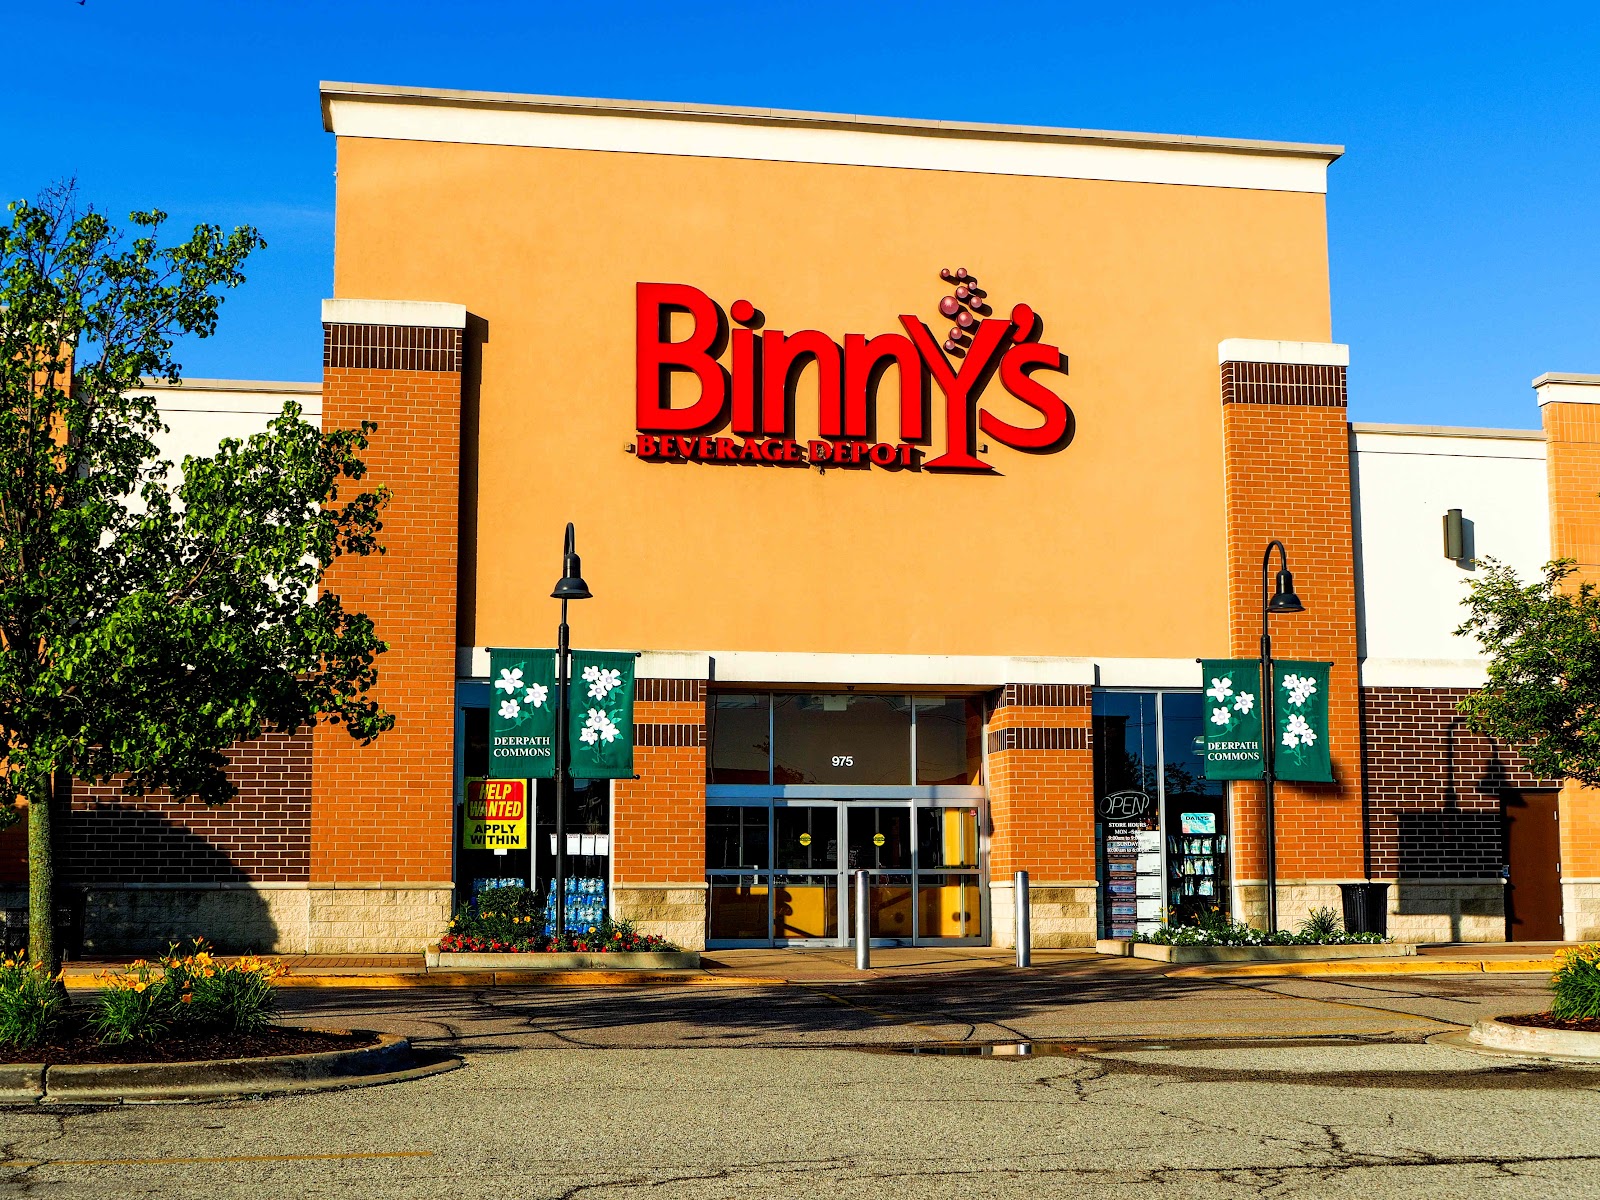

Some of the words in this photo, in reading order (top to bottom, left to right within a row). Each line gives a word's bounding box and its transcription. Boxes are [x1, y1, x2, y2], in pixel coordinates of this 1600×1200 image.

[636, 434, 799, 461] BEVERAGE
[807, 439, 915, 466] DEPOT
[493, 736, 551, 746] DEERPATH
[1207, 741, 1259, 750] DEERPATH
[493, 747, 551, 757] COMMONS
[1207, 751, 1260, 761] COMMONS
[831, 755, 854, 767] 975
[478, 783, 512, 800] HELP
[469, 801, 522, 817] WANTED
[1100, 796, 1146, 815] OPEN
[474, 824, 516, 834] APPLY
[470, 835, 520, 845] WITHIN
